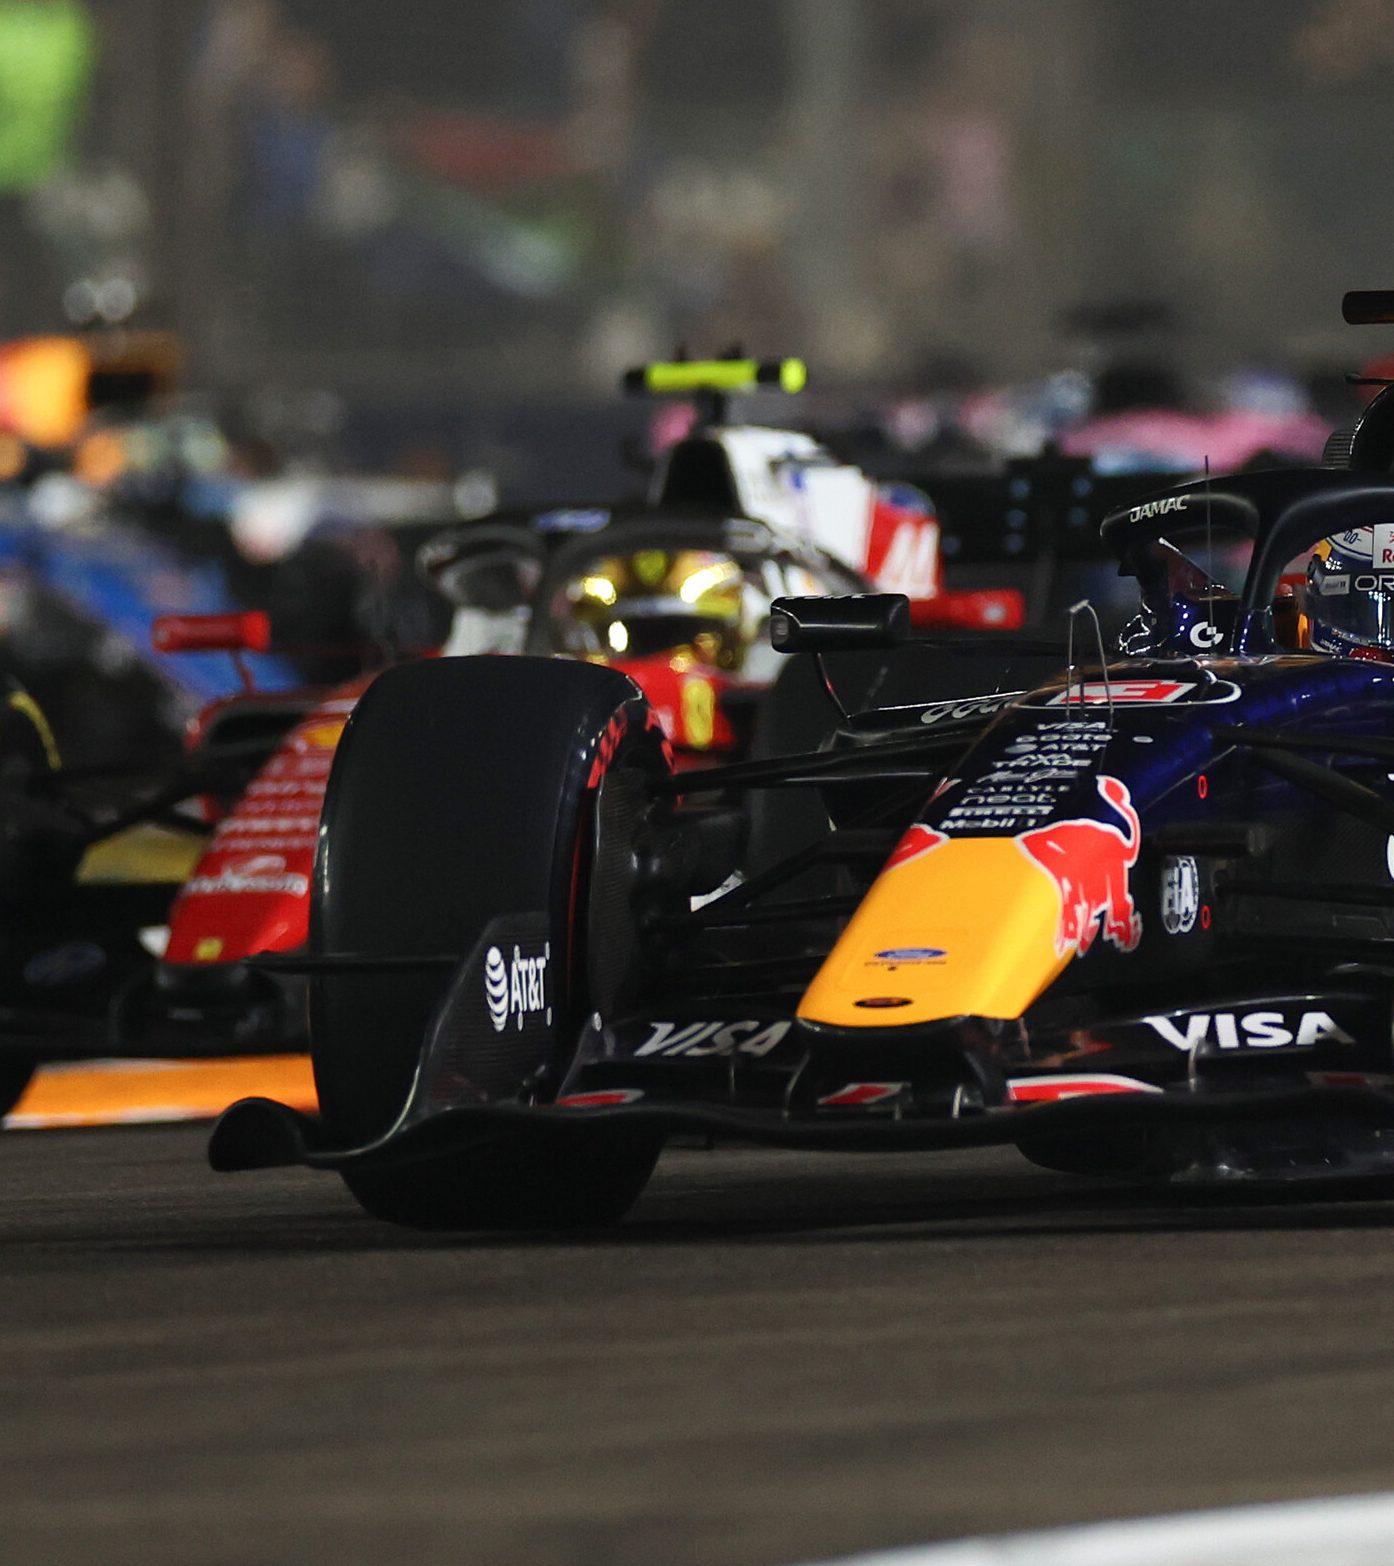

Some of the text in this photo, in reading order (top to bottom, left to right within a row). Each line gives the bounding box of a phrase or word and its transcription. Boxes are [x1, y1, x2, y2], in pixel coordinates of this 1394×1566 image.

[510, 956, 546, 1014] AT&T
[633, 1020, 792, 1057] VISA
[1142, 1011, 1357, 1052] VISA
